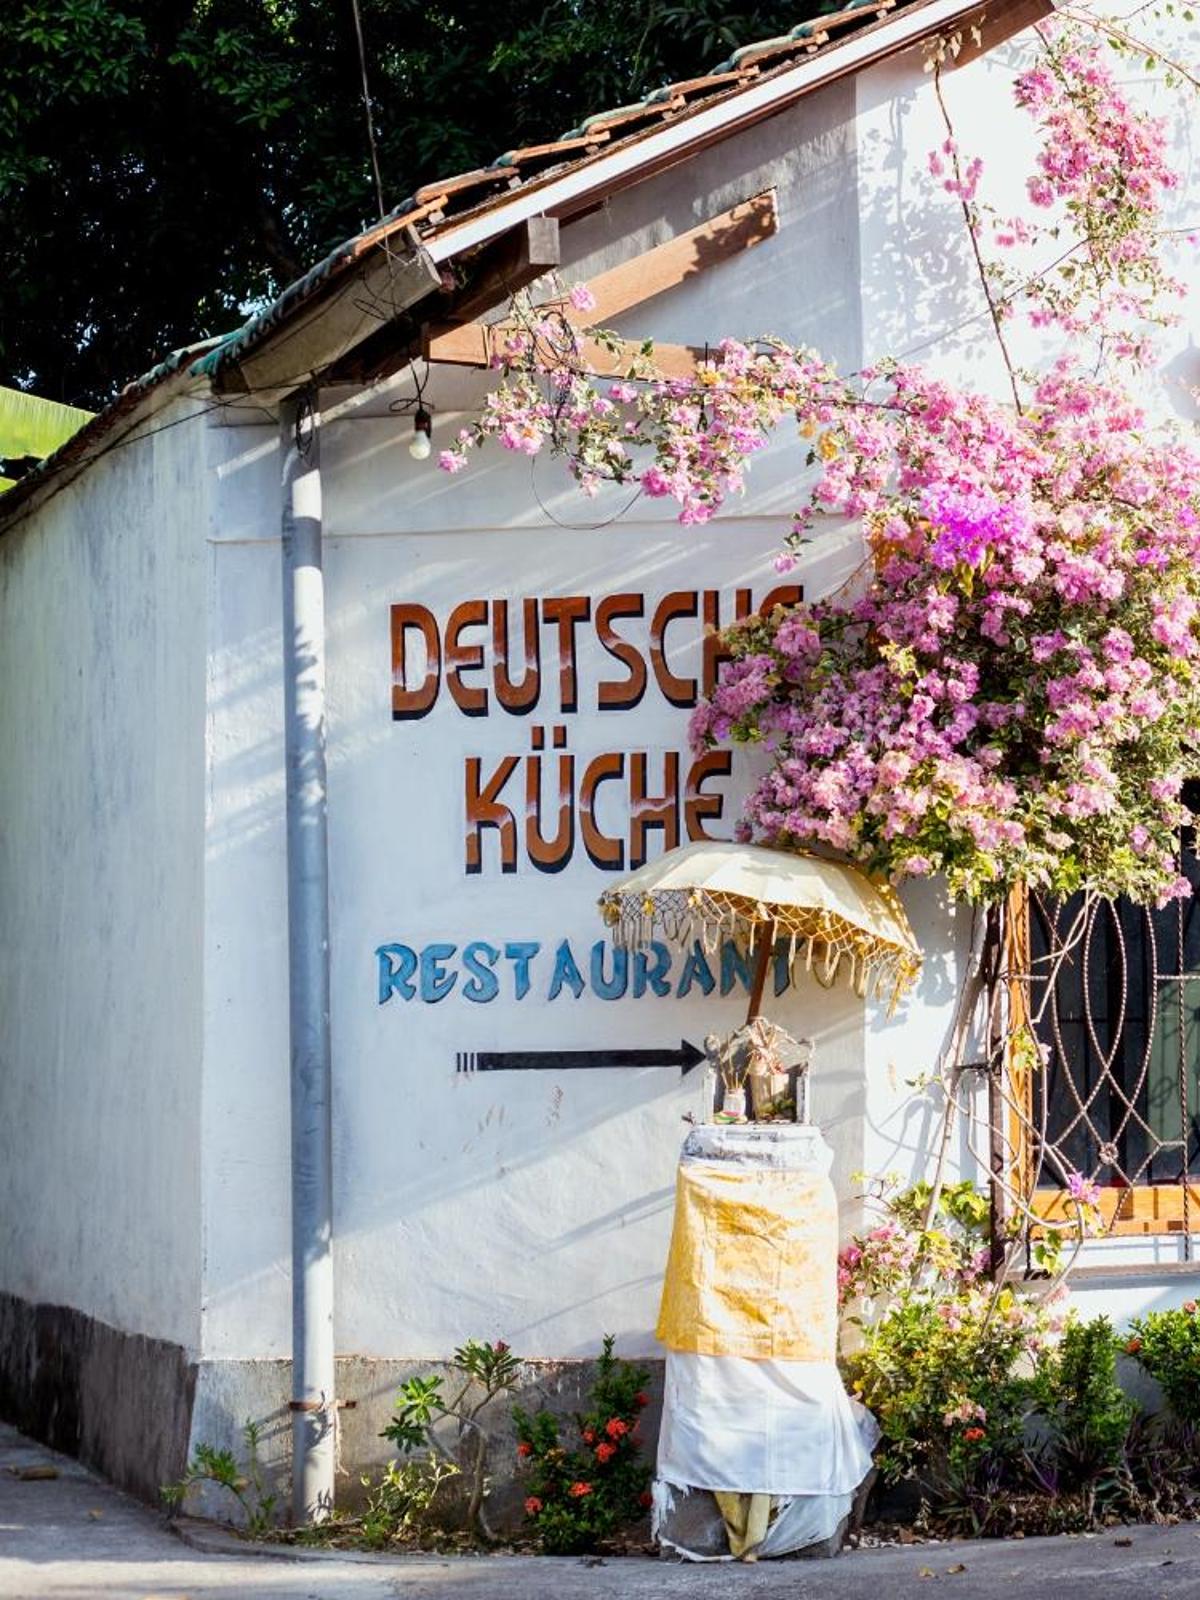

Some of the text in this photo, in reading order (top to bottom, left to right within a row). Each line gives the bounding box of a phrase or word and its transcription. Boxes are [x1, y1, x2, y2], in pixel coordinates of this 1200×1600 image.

[389, 584, 804, 721] DEUTSCH
[465, 725, 733, 875] KÜCHE
[375, 938, 805, 1006] RESTAURANT
